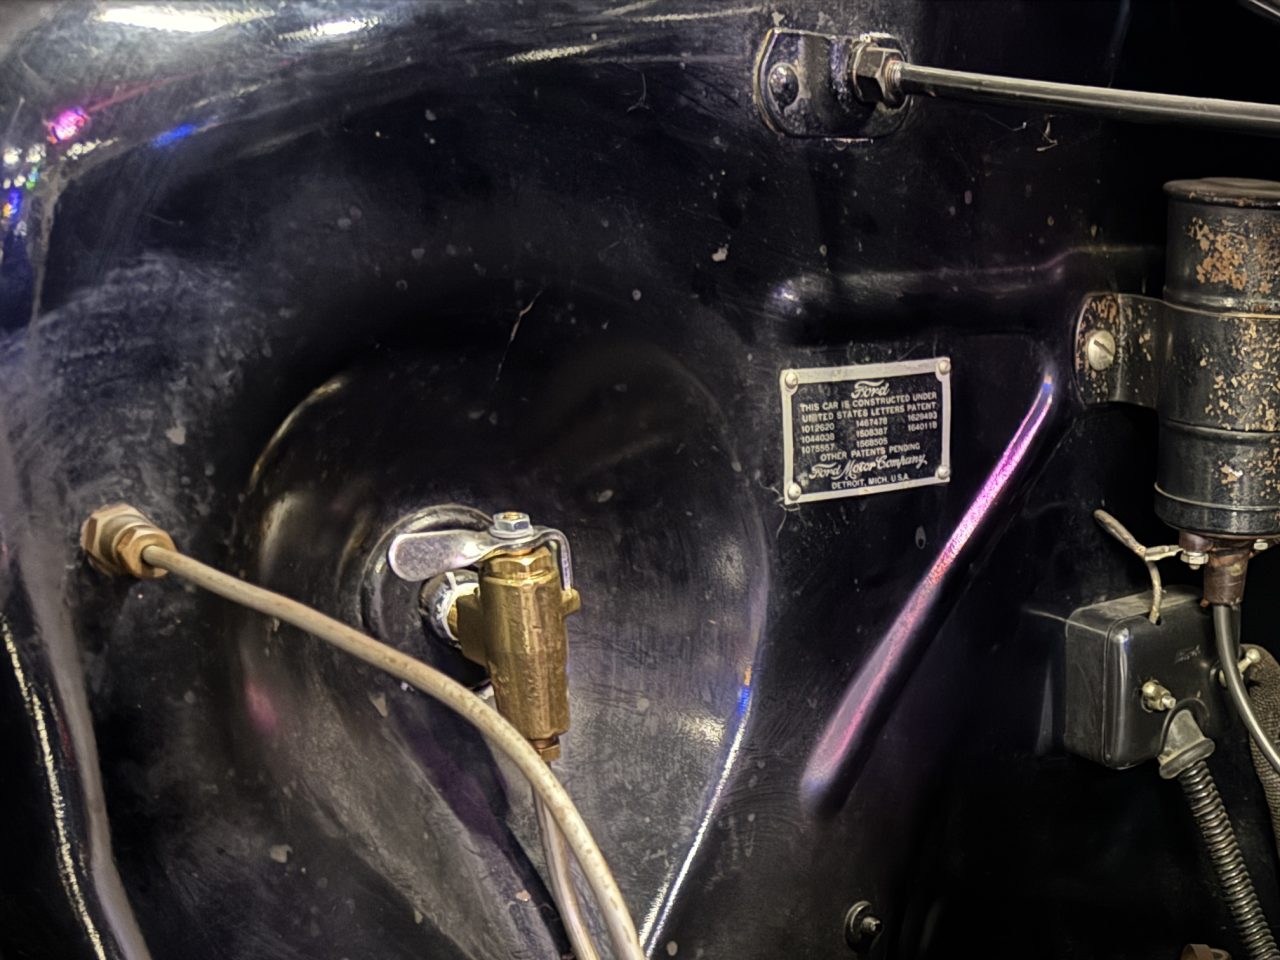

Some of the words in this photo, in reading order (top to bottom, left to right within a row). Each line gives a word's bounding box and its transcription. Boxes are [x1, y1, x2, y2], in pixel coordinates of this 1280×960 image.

[851, 379, 890, 399] Ford
[800, 402, 820, 412] THIS
[822, 400, 839, 411] CAR
[841, 400, 850, 410] IS
[852, 395, 910, 408] CONSTRUCTED
[912, 391, 938, 402] UNDER
[836, 408, 869, 420] STATES
[870, 404, 905, 417] LETTERS
[906, 401, 937, 412] PATENT
[801, 422, 836, 434] 1012620
[820, 451, 848, 462] OTHER
[850, 446, 886, 458] PATENTS
[889, 442, 921, 454] PENDING
[808, 461, 842, 480] Ford
[831, 458, 877, 481] Motor
[875, 453, 928, 470] Company
